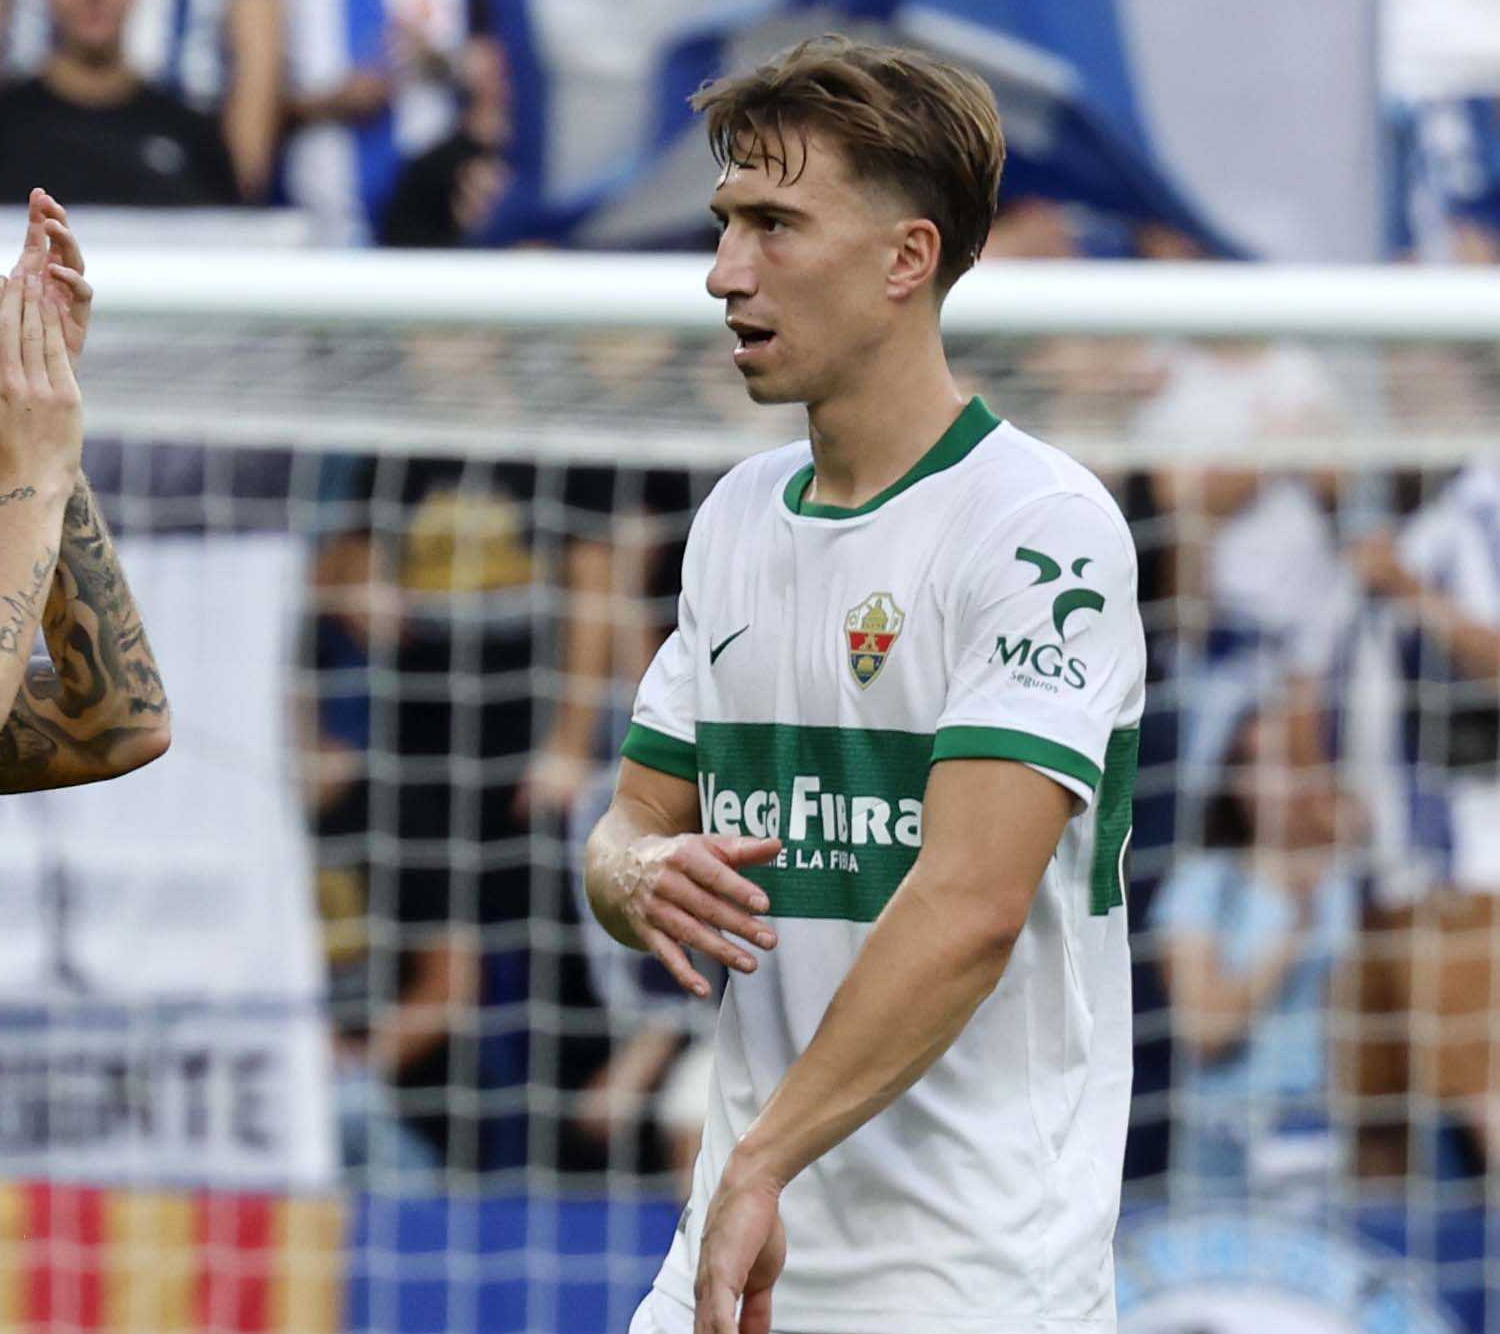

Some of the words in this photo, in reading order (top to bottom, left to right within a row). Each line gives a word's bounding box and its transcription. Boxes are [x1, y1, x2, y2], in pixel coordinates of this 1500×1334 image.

[988, 635, 1088, 690] MGS
[1010, 669, 1060, 694] Seguros
[796, 848, 824, 870] LA
